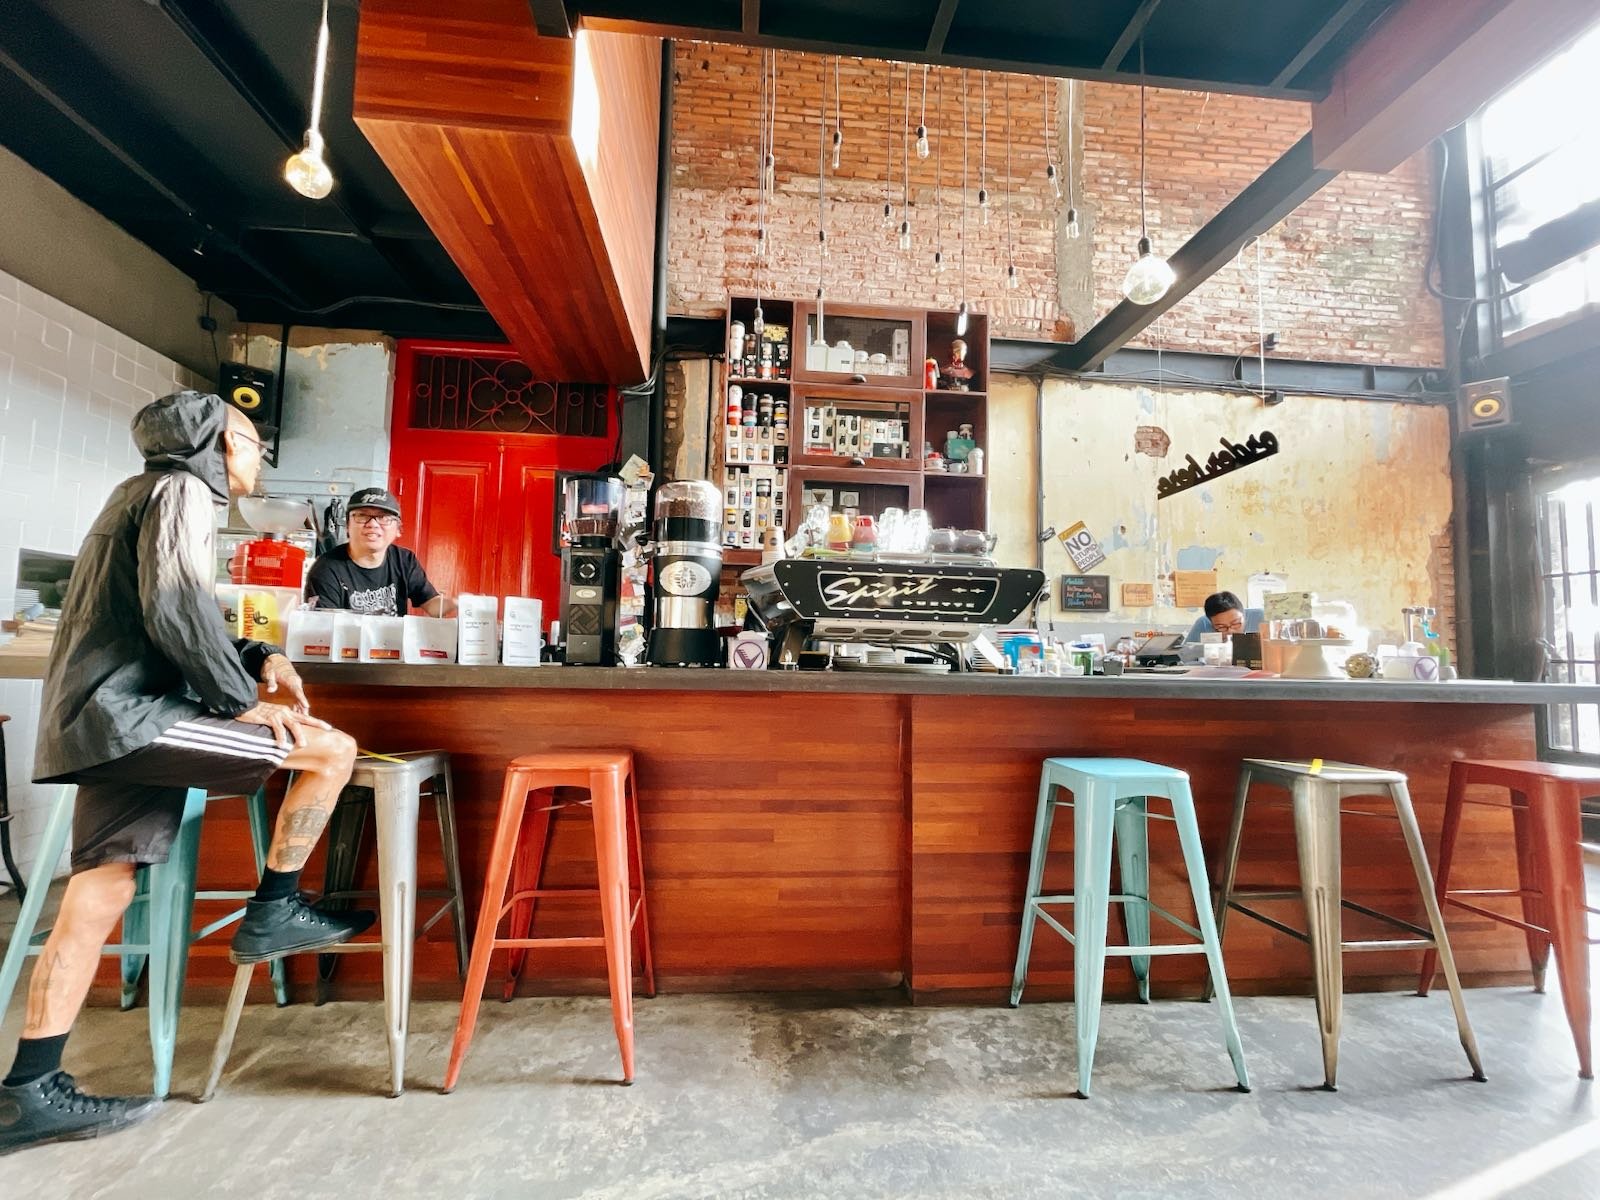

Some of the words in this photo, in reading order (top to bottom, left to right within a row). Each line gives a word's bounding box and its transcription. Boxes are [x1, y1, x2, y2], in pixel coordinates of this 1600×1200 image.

[1065, 531, 1091, 555] NO
[1074, 543, 1098, 561] STUPID
[1078, 550, 1101, 568] PEOPLE
[824, 576, 939, 606] Spirit
